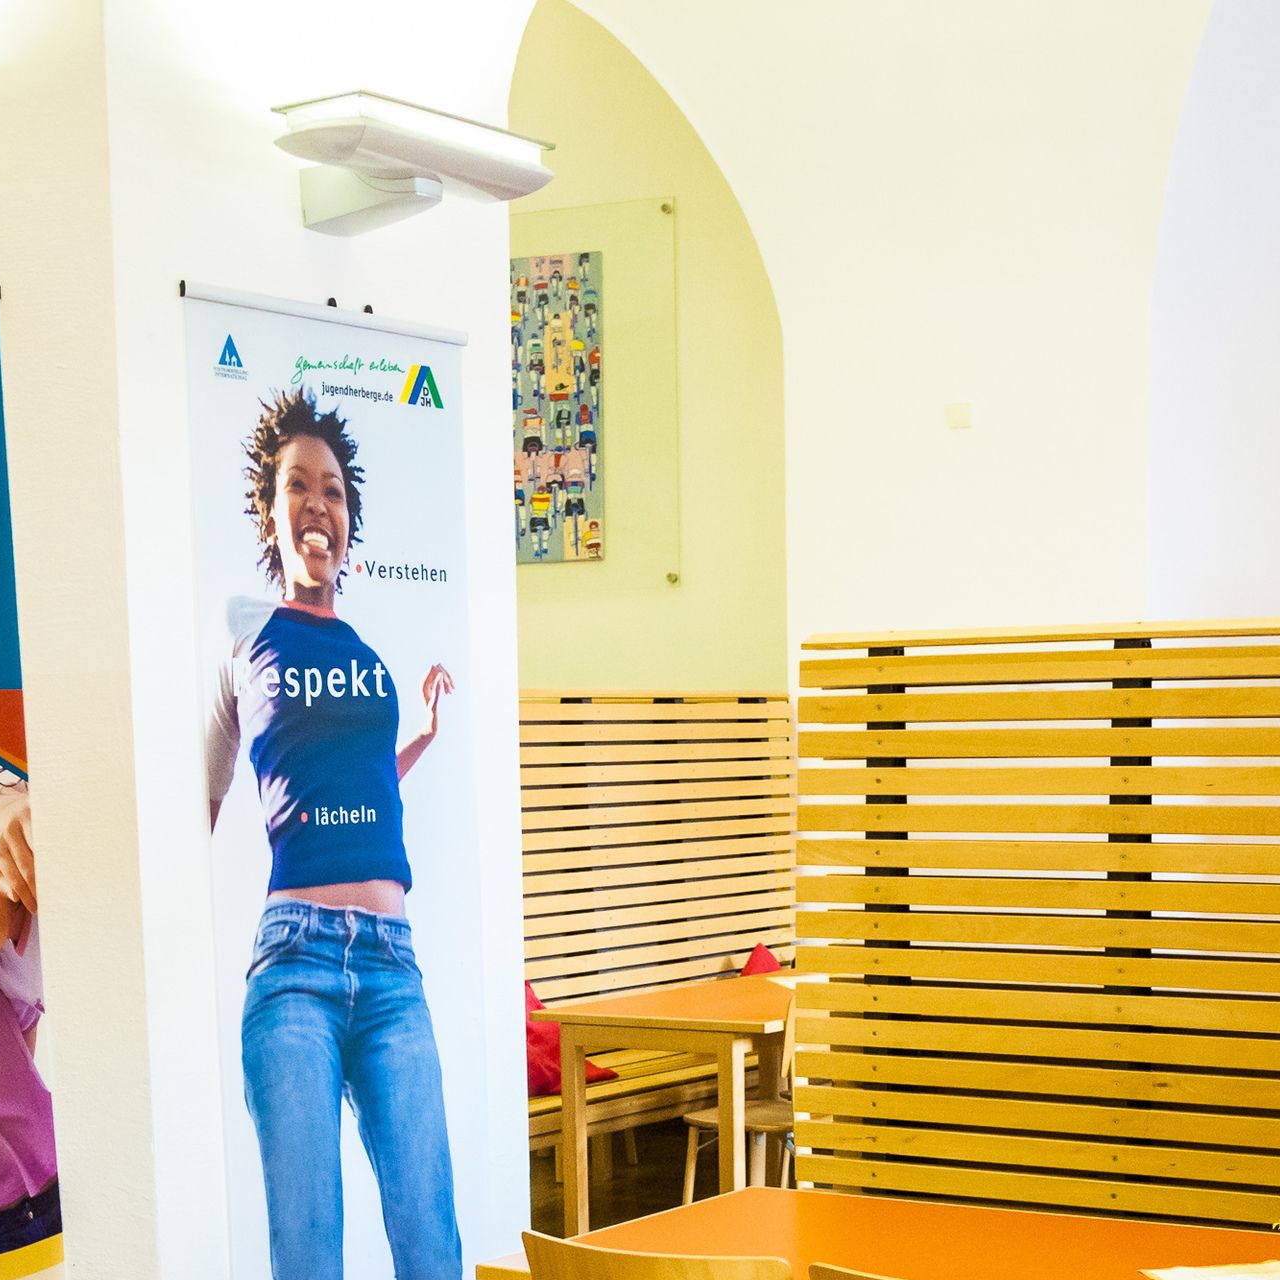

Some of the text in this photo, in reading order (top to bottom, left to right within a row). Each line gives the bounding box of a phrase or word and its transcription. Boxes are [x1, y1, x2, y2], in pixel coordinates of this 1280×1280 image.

[369, 358, 406, 374] erleben
[321, 380, 394, 403] jugendherberge.de
[365, 560, 448, 583] Verstehen
[315, 805, 377, 826] lächeln
